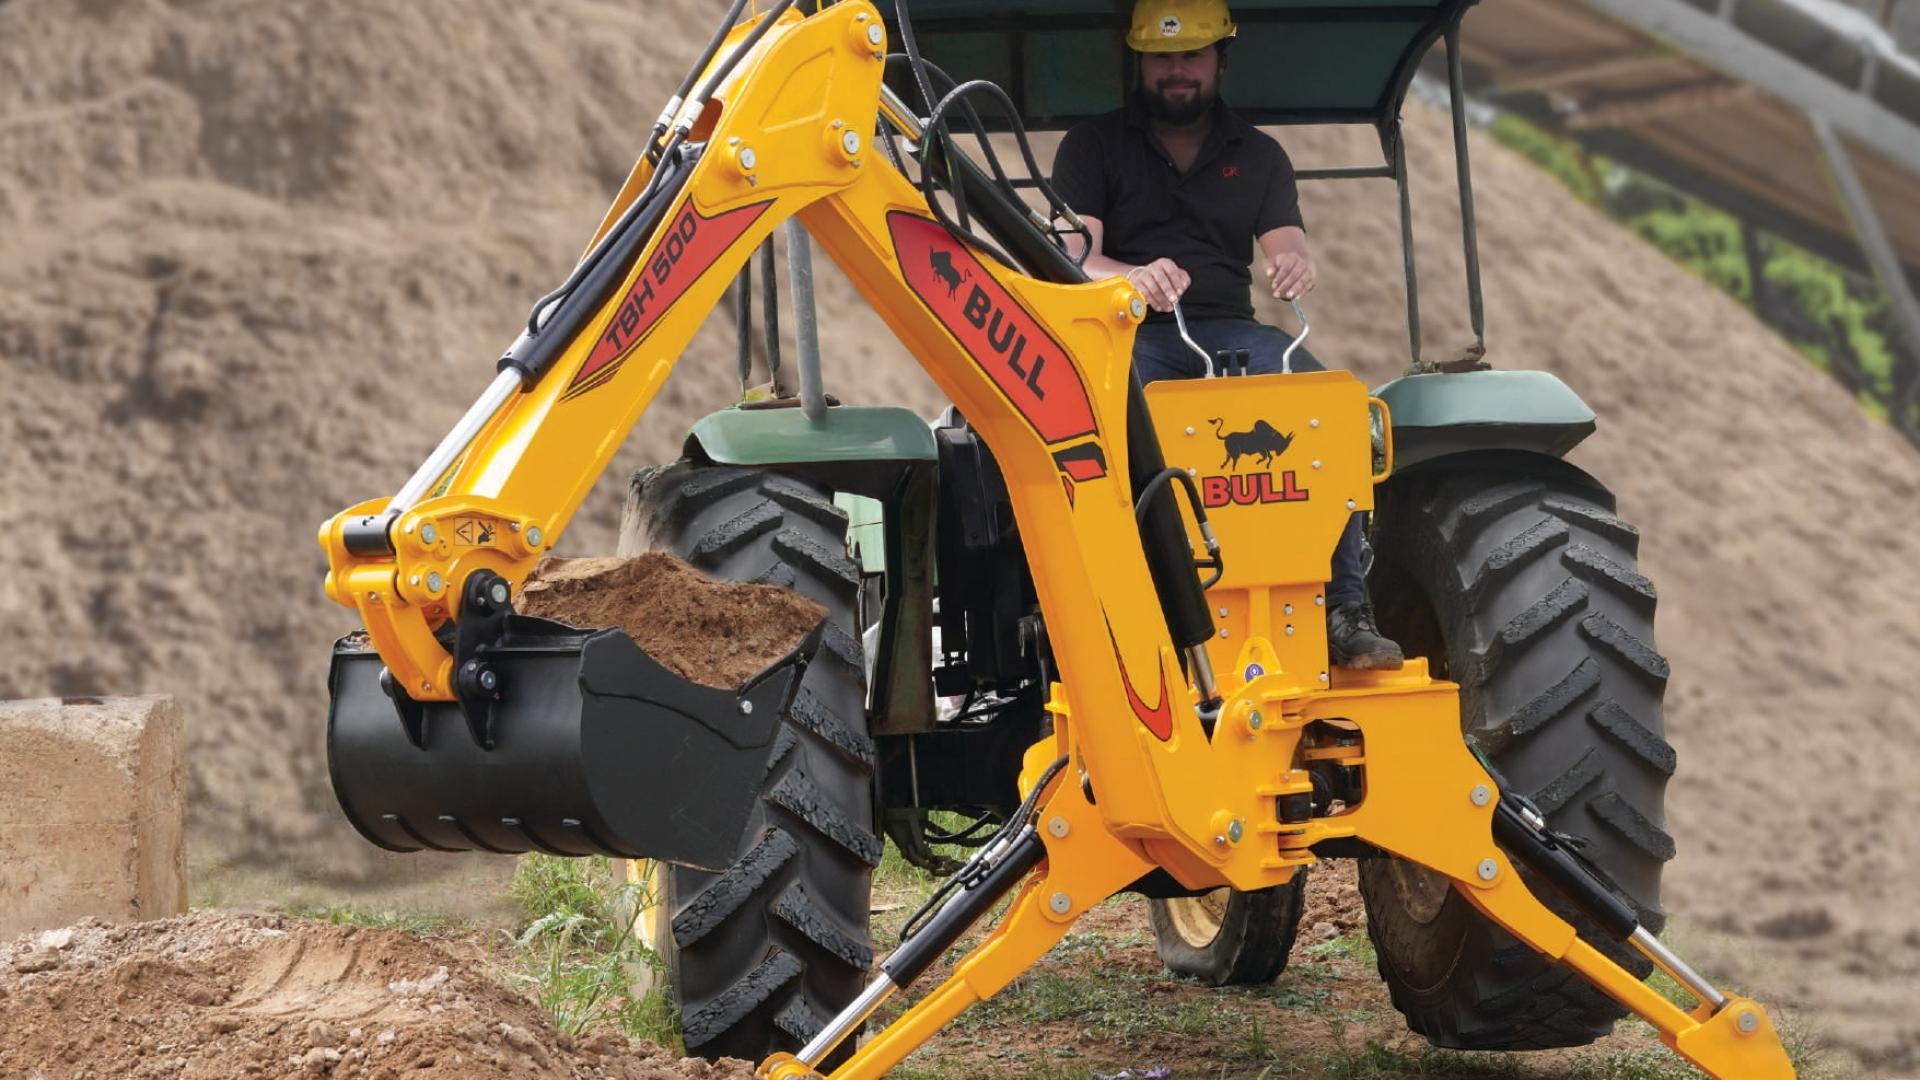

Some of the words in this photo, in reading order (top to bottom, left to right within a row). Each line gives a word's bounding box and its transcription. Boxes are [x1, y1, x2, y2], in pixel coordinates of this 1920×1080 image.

[605, 278, 655, 350] TBH
[652, 211, 697, 286] 500
[963, 283, 1045, 401] BULL
[1202, 470, 1309, 508] BULL
